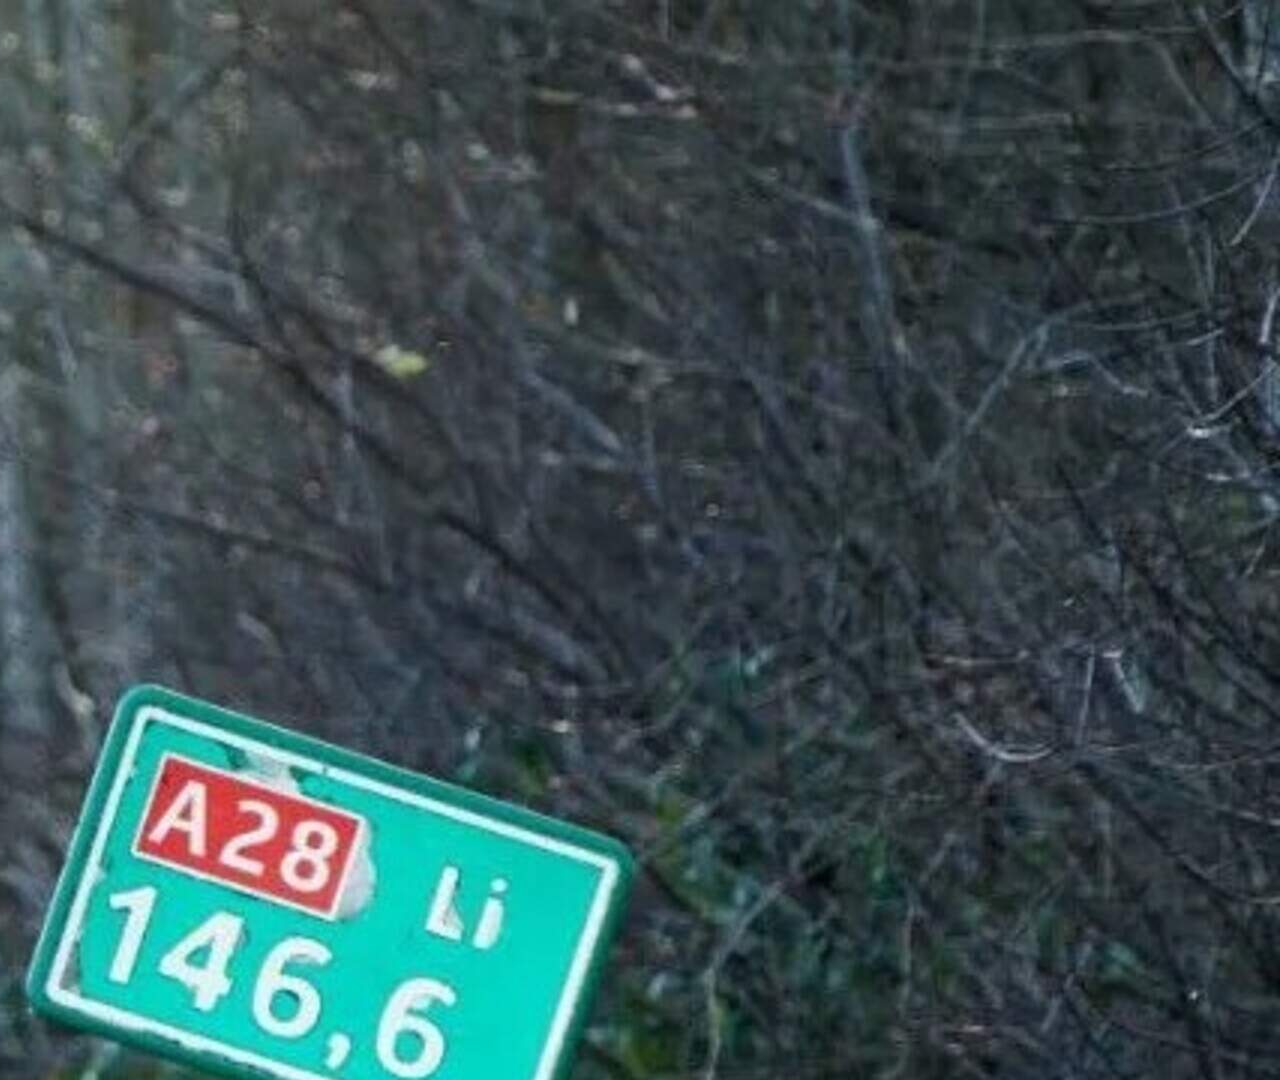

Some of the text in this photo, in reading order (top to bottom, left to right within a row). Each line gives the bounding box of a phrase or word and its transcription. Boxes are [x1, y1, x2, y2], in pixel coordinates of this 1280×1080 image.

[148, 779, 339, 893] A28
[426, 867, 508, 949] Li
[109, 886, 455, 1079] 146,6
